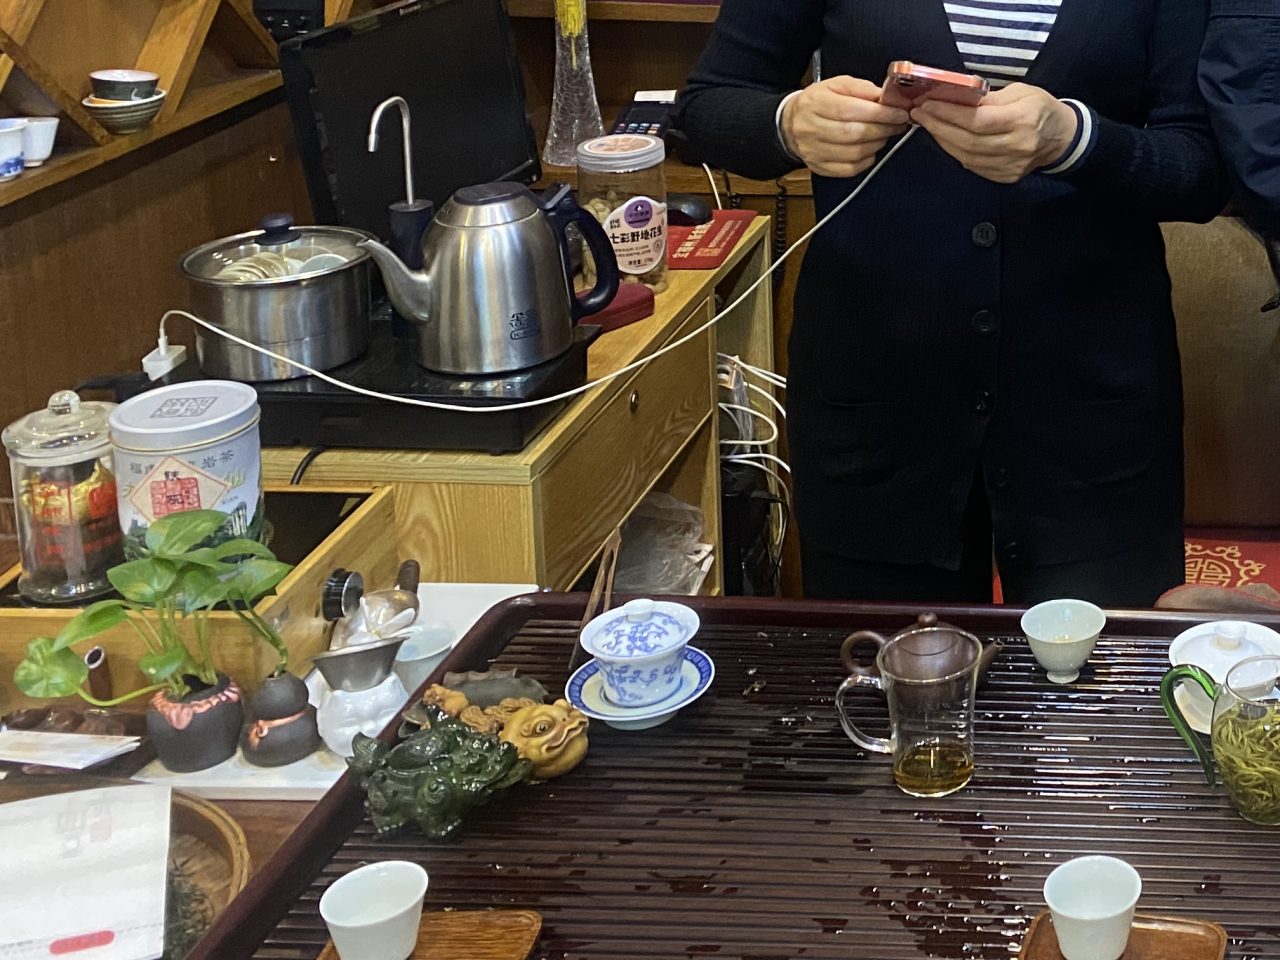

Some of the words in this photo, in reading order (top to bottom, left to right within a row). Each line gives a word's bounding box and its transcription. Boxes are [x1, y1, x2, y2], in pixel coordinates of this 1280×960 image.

[609, 224, 664, 245] 七彩野地花生
